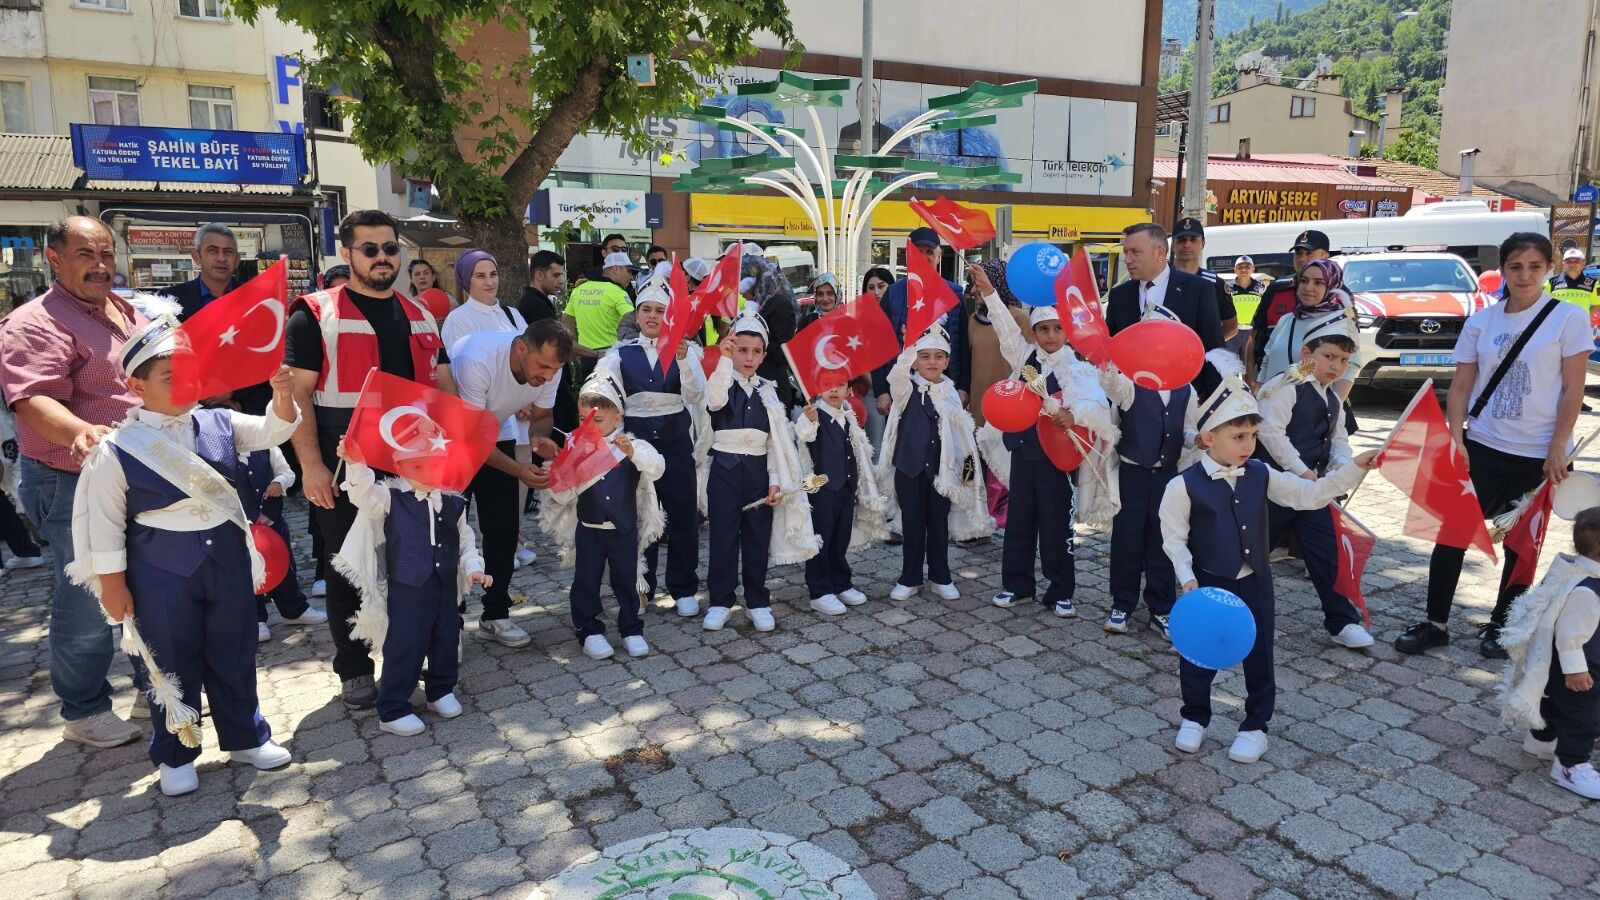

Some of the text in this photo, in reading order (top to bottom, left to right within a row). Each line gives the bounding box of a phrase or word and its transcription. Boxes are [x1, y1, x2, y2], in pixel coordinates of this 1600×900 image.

[147, 139, 240, 156] ŞAHİN BÜFE
[151, 155, 239, 171] TEKEL BAYİ
[1042, 160, 1108, 174] Türk Telekom
[1280, 190, 1319, 206] SEBZE
[558, 203, 622, 214] Türk elekom
[1223, 206, 1322, 224] MEYVE DÜNYASI
[140, 231, 163, 239] PARÇA
